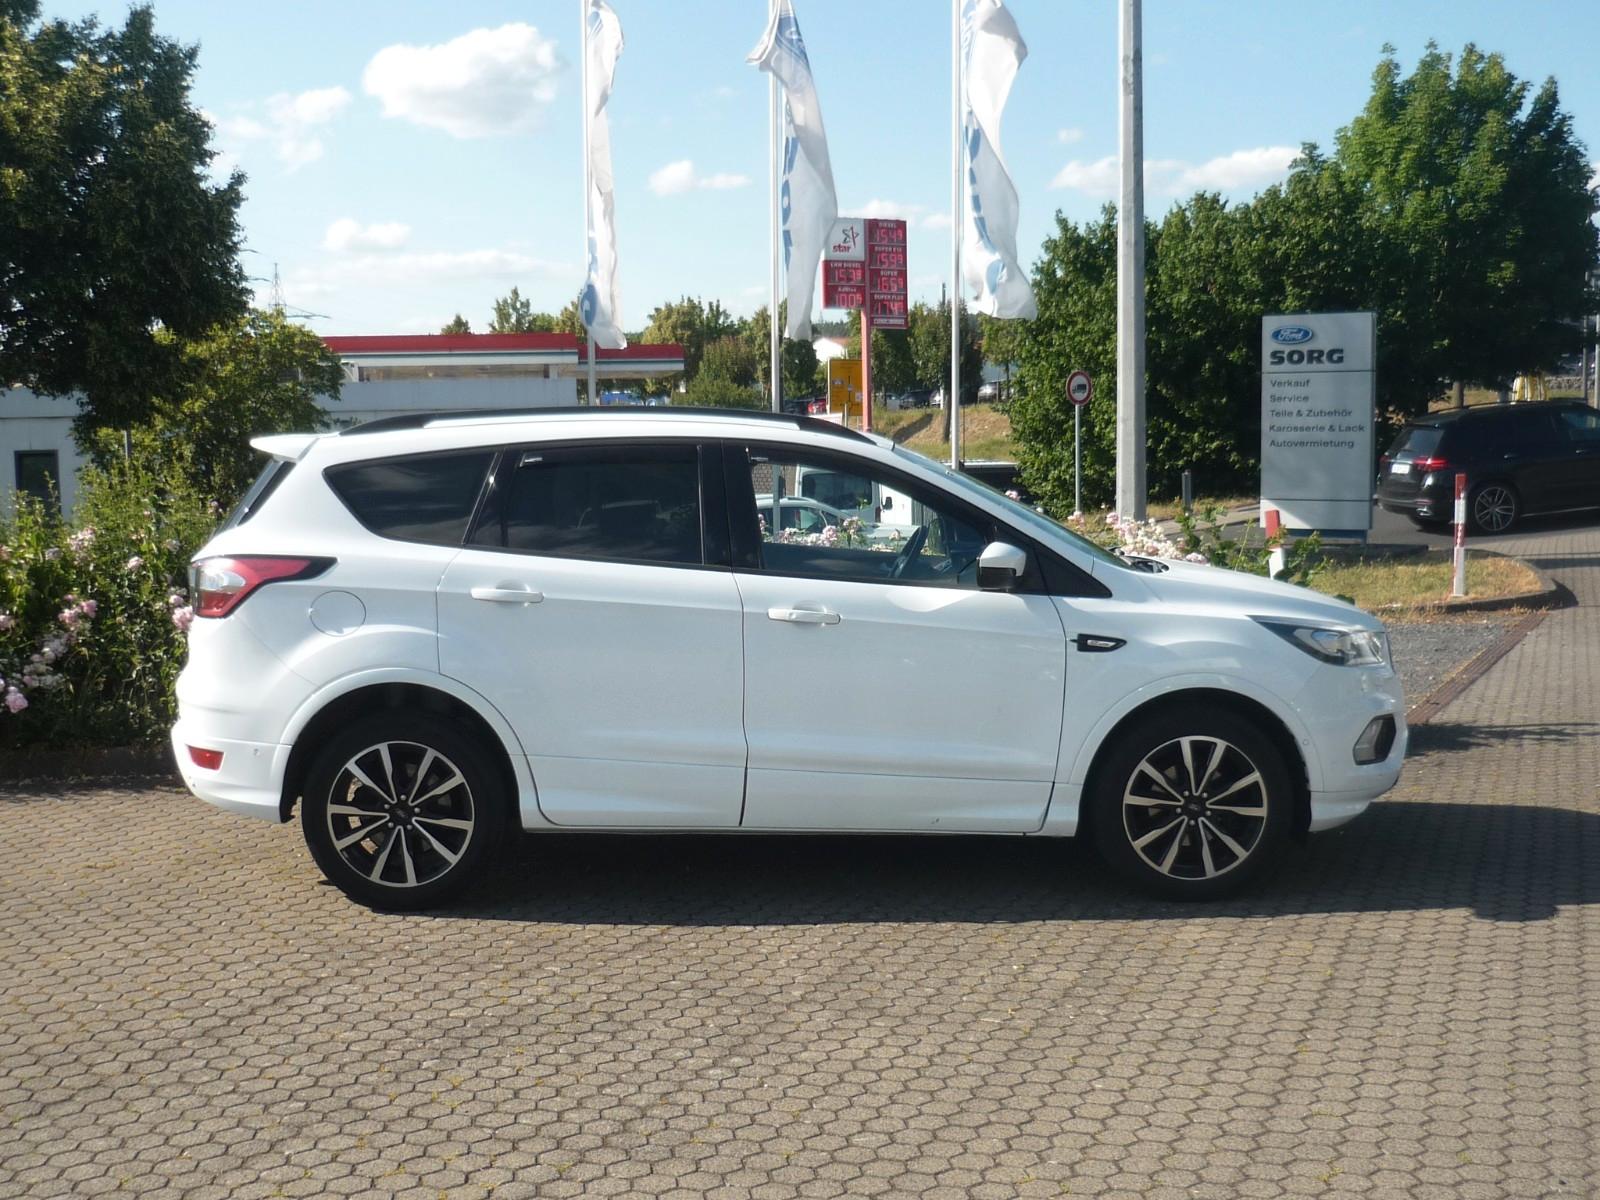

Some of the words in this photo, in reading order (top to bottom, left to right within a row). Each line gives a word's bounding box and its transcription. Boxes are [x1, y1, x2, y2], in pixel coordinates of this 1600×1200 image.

[832, 244, 852, 253] star
[1277, 328, 1304, 341] Ford
[1270, 348, 1345, 366] SORG
[1270, 379, 1310, 388] Verkauf
[1270, 394, 1309, 403] Service
[1270, 409, 1293, 418] Teile
[1295, 409, 1303, 418] &
[1306, 408, 1353, 418] Zubehör
[1269, 424, 1325, 433] Karosserie
[1327, 424, 1336, 433] &
[1338, 424, 1365, 433] Lack
[1269, 439, 1355, 449] Autovermietung
